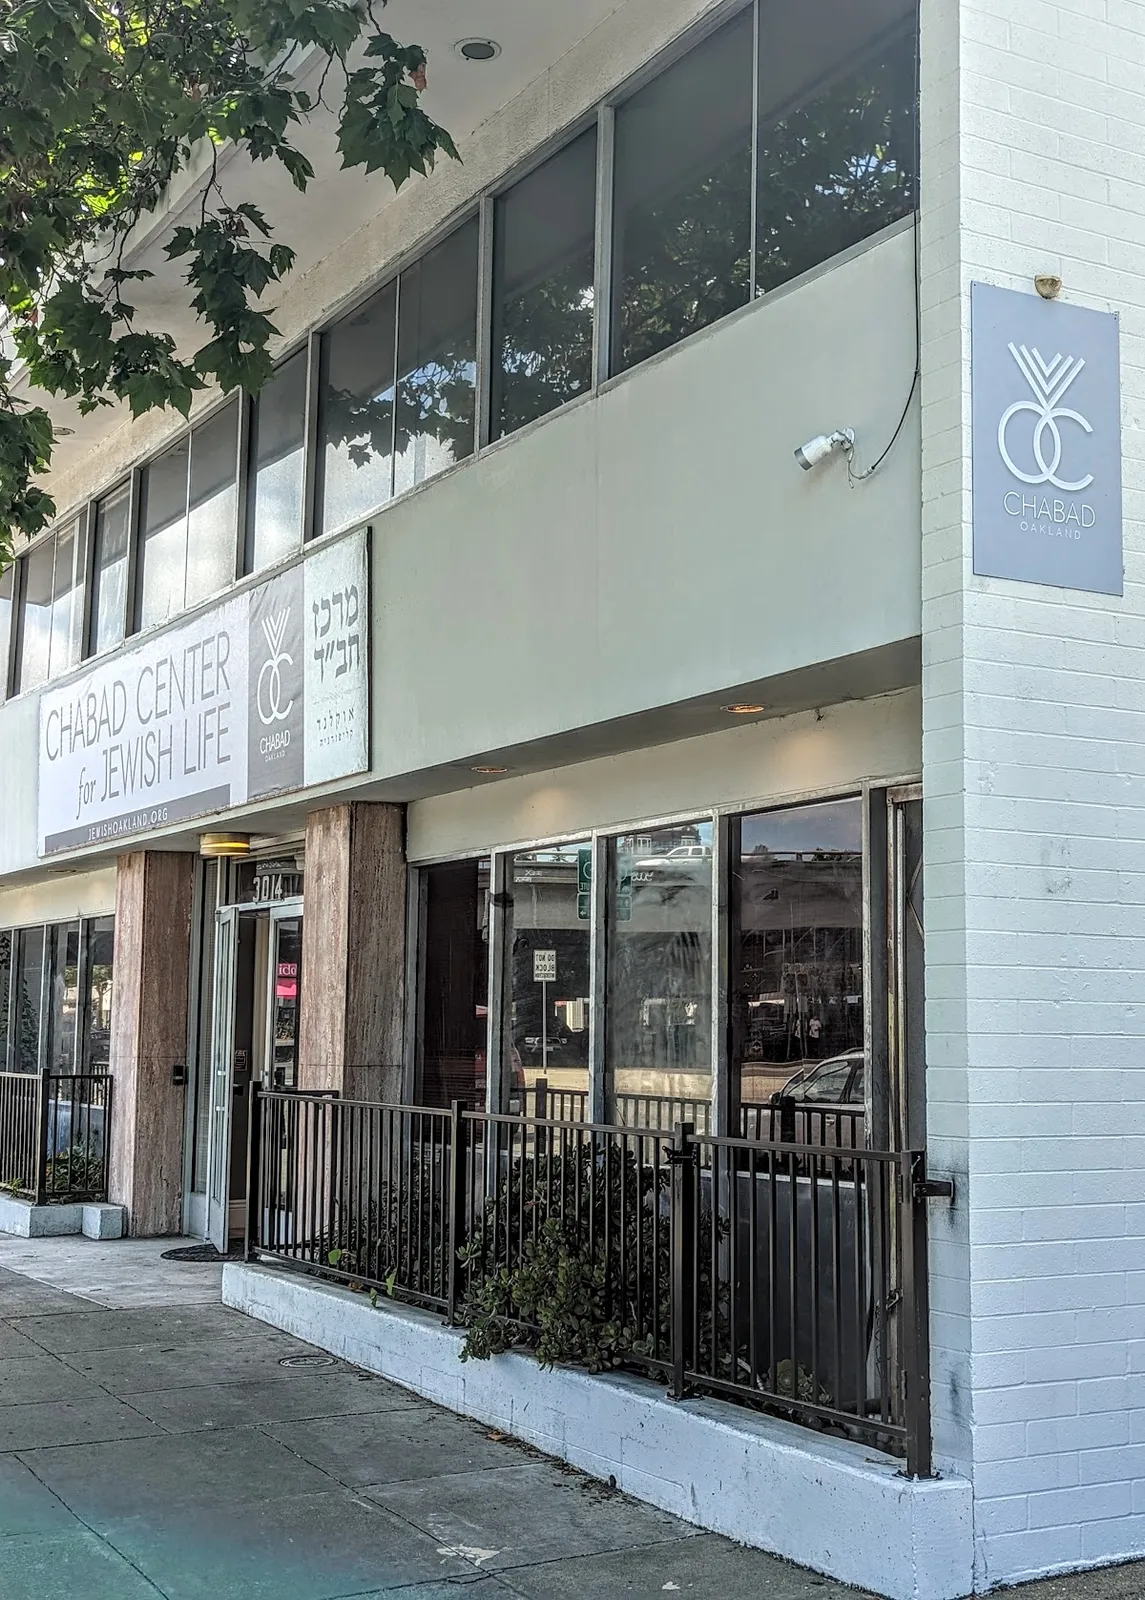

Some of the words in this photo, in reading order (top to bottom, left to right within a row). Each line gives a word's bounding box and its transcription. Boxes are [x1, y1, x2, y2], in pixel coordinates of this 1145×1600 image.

[1003, 491, 1096, 529] CHABAD
[1020, 521, 1082, 541] OAKLAND
[312, 584, 359, 640] מרכז
[46, 680, 127, 762] CHABAD
[136, 631, 231, 725] CENTER
[259, 729, 291, 755] CHABAD
[264, 750, 286, 763] OAKLAND
[76, 766, 97, 820] for
[100, 724, 173, 803] JEWISH
[183, 702, 231, 776] LIFE
[87, 807, 168, 841] JEWISHOAKLAND.ORG
[252, 874, 283, 902] 3014
